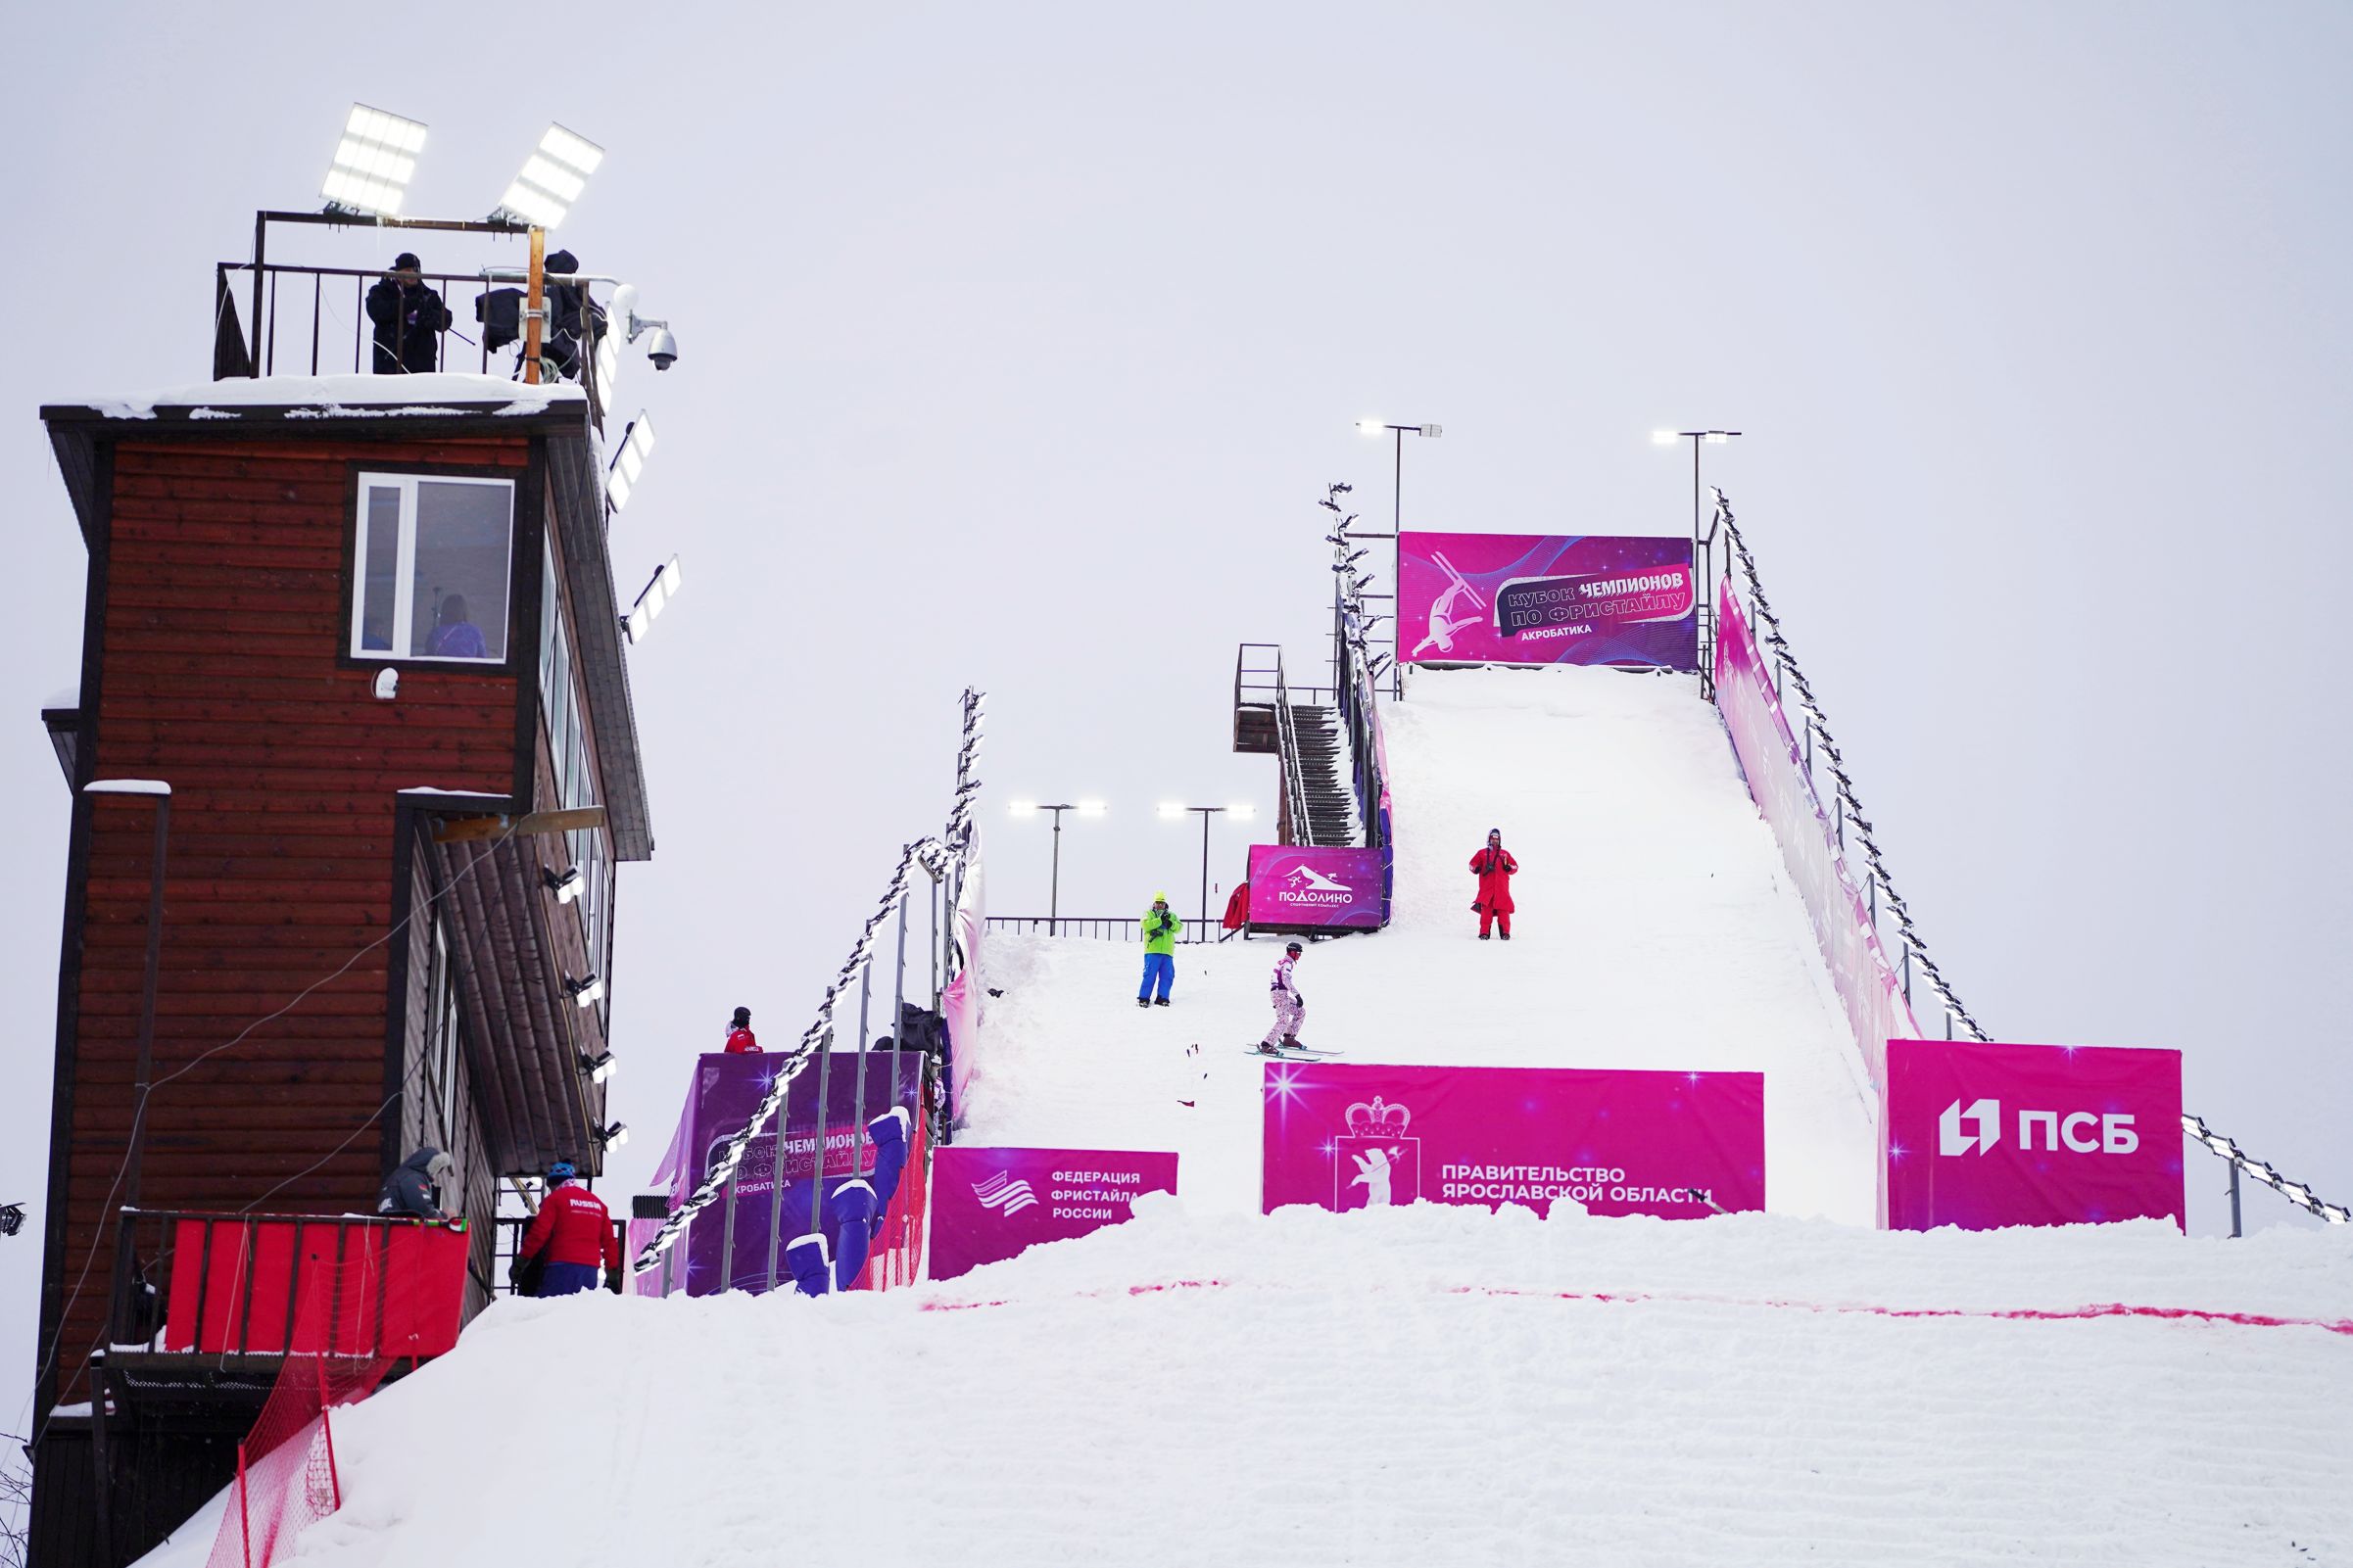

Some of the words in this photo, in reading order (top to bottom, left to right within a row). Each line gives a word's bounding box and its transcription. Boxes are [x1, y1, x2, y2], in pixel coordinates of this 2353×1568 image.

[1508, 588, 1575, 607] КУБОК
[1578, 572, 1684, 598] ЧЕМПИОНОВ
[1511, 609, 1542, 626] ПО
[1548, 593, 1686, 621] ФРИСТАЙЛУ
[1521, 624, 1592, 641] АКРОБАТИКА
[1278, 890, 1352, 903] ПОДОЛИНО
[2018, 1110, 2139, 1154] ПСБ
[1051, 1170, 1140, 1185] ФЕДЕРАЦИЯ
[1442, 1164, 1626, 1183] ПРАВИТЕЛЬСТВО
[1442, 1183, 1603, 1201] ЯРОСЛАВСКОЙ
[1609, 1186, 1712, 1204] ОБЛАСТИ
[569, 1199, 601, 1212] RUSSIA
[1053, 1208, 1112, 1219] РОССИИ
